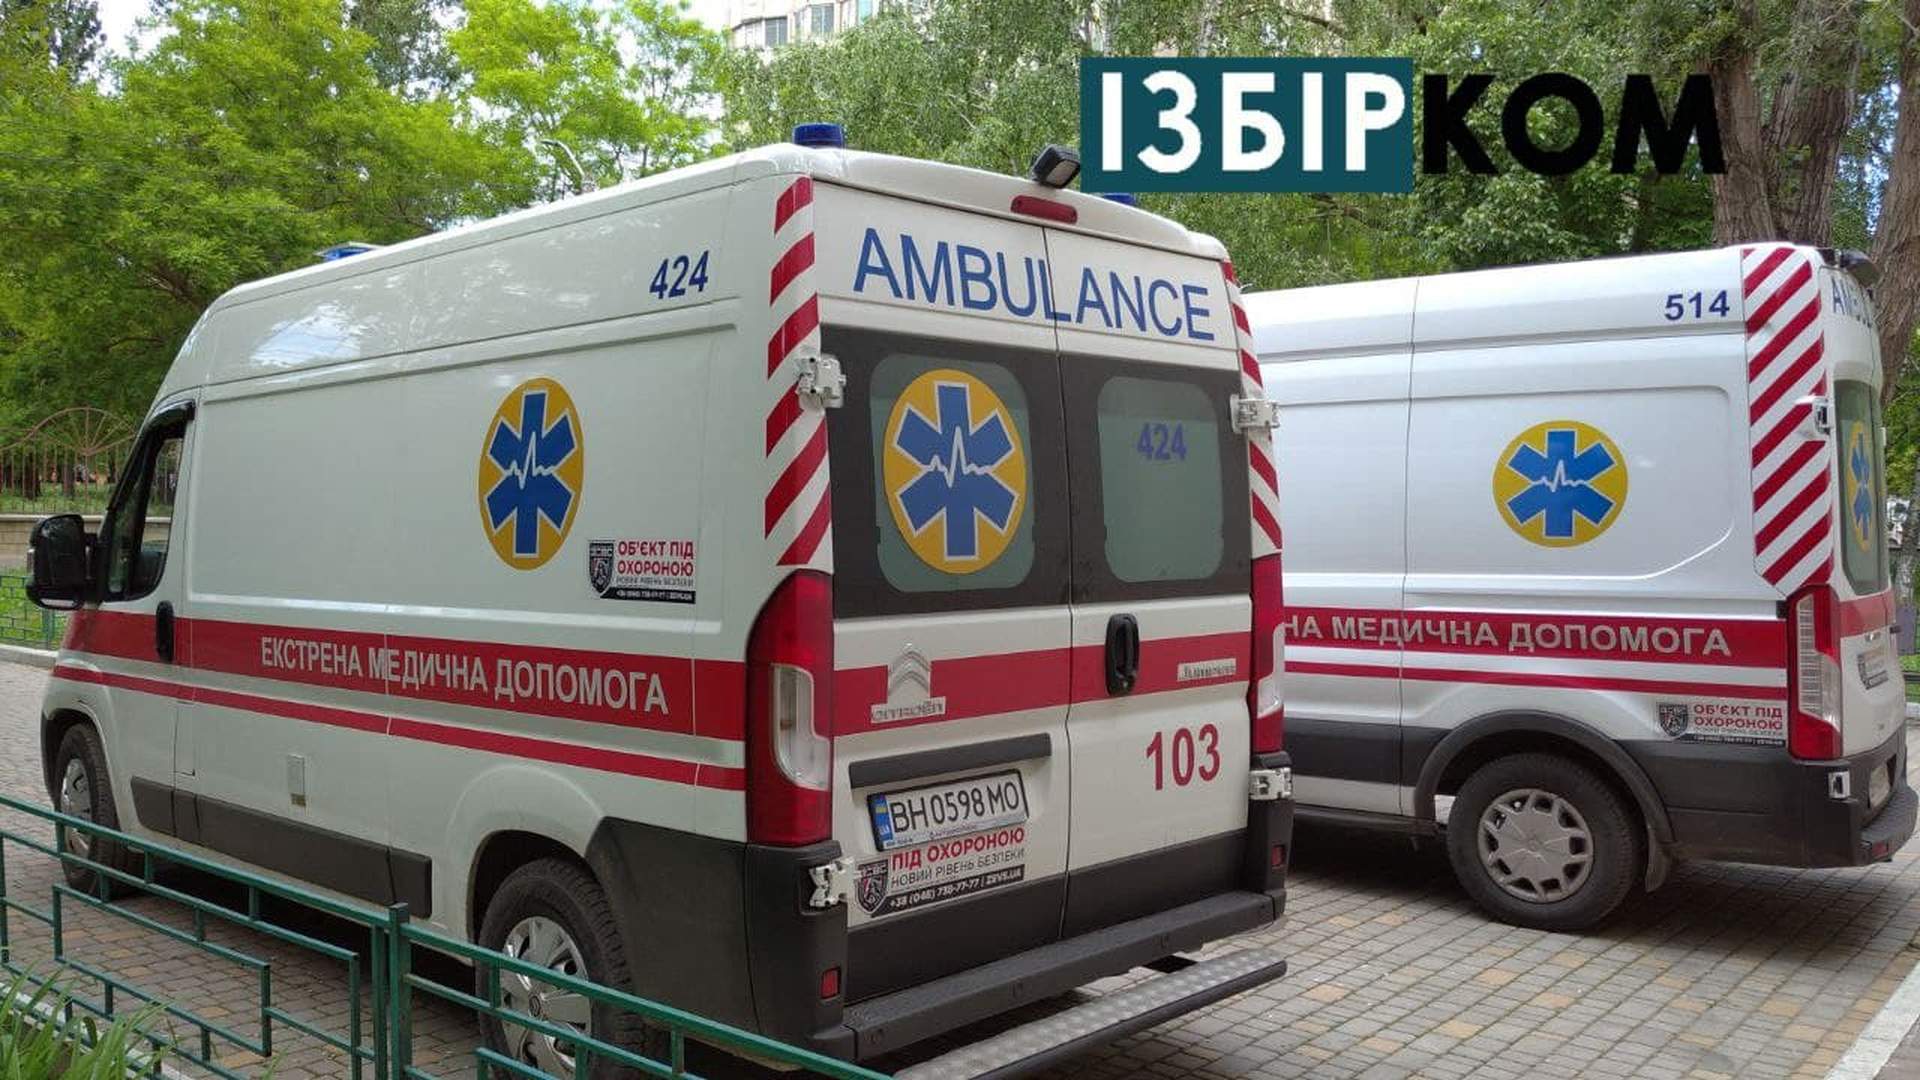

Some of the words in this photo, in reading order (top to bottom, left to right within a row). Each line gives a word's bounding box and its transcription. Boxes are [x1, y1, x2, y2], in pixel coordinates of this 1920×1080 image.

[649, 250, 709, 300] 424
[853, 227, 1215, 342] AMBULANCE
[1664, 289, 1730, 321] 514
[1136, 422, 1187, 461] 424
[617, 560, 694, 577] ОХОРОНОЮ
[618, 541, 666, 556] ОБ'ЄКТ
[669, 541, 694, 559] ПІД
[1331, 615, 1498, 647] МЕДИЧНА
[1508, 622, 1731, 657] ДОПОМОГА
[261, 636, 363, 678] ЕКСТРЕНА
[368, 646, 488, 692] МЕДИЧНА
[494, 658, 669, 715] ДОПОМОГА
[1693, 717, 1783, 731] ОХОРОНОЮ
[1755, 707, 1783, 719] ПІД
[1146, 723, 1220, 791] 103
[930, 788, 985, 824] 0598
[892, 849, 922, 871] ПІД
[927, 827, 1025, 863] ОХОРОНОЮ
[891, 867, 932, 889] НОВИЙ
[936, 859, 975, 877] РІВЕНЬ
